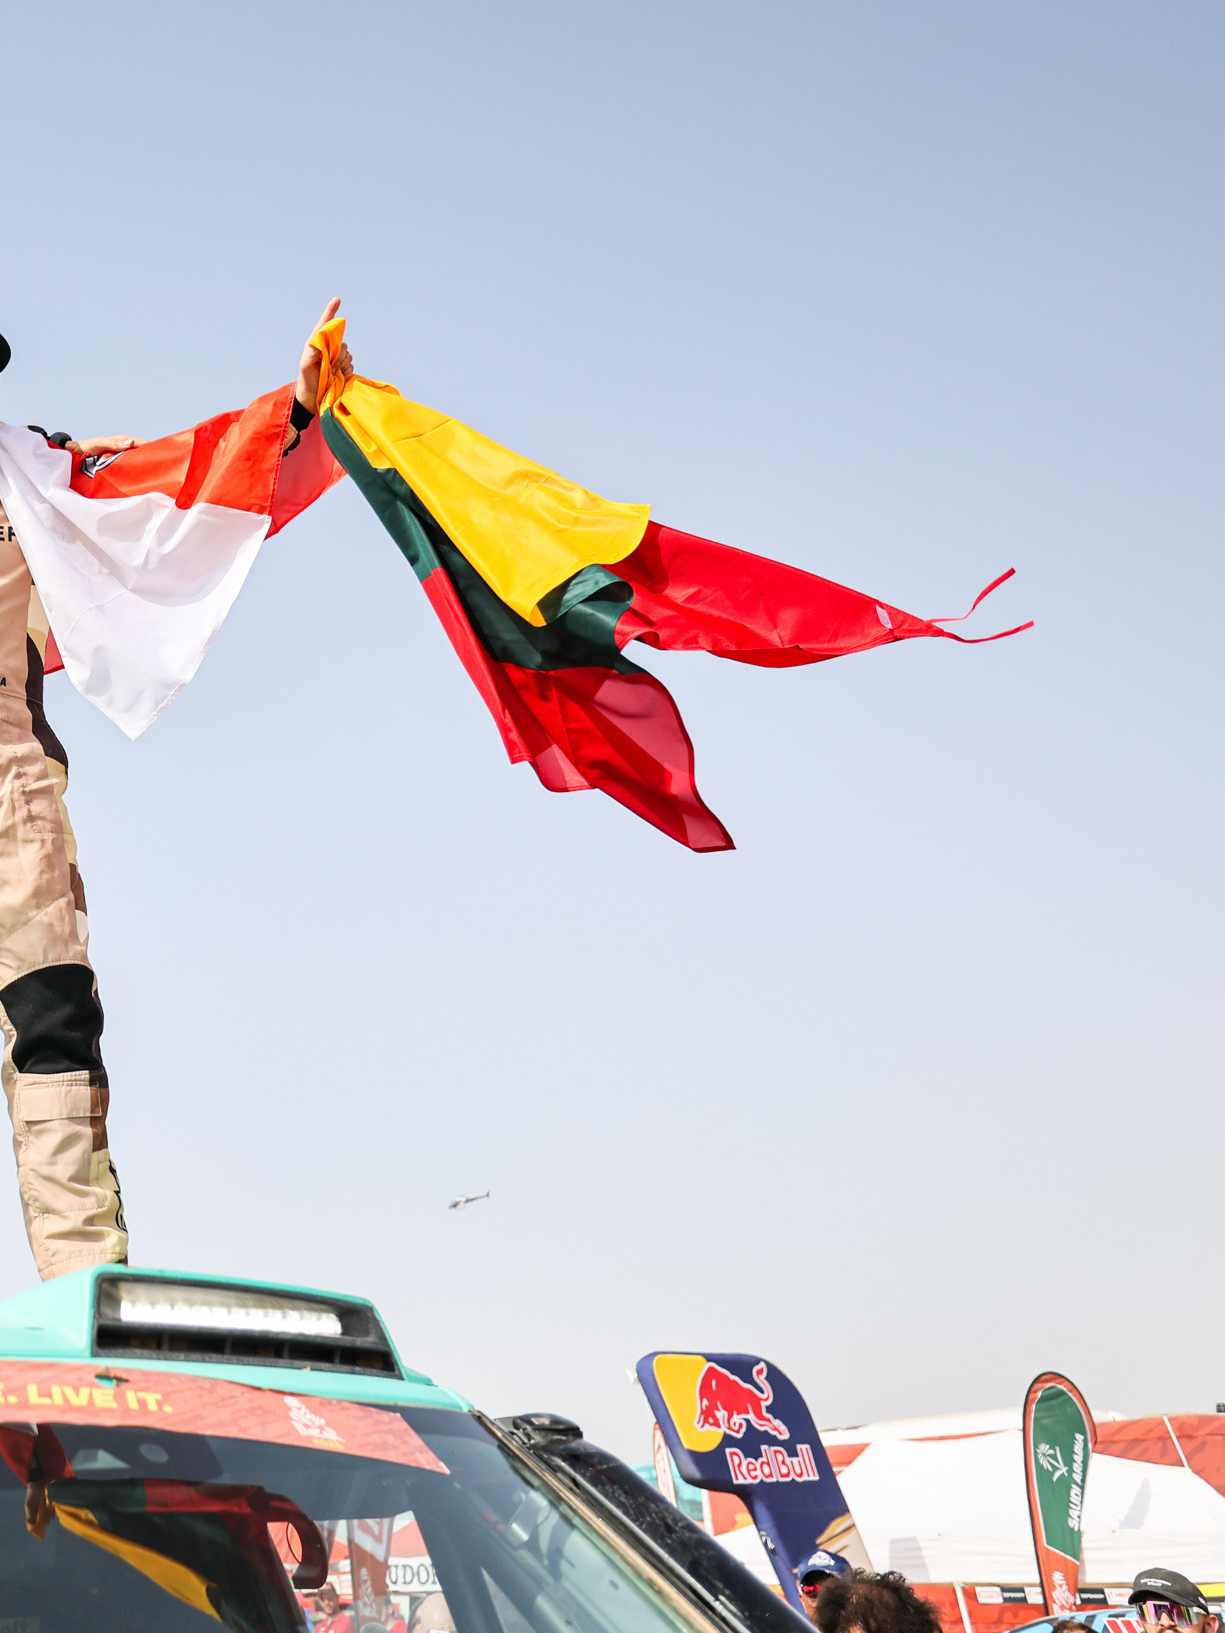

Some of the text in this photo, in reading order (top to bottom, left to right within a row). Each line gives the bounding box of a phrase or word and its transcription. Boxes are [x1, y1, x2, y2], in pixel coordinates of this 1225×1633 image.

[27, 1384, 117, 1408] LIVE
[127, 1391, 173, 1412] IT.
[727, 1446, 818, 1482] Red Bull
[1067, 1432, 1085, 1532] SAUDI ARABIA
